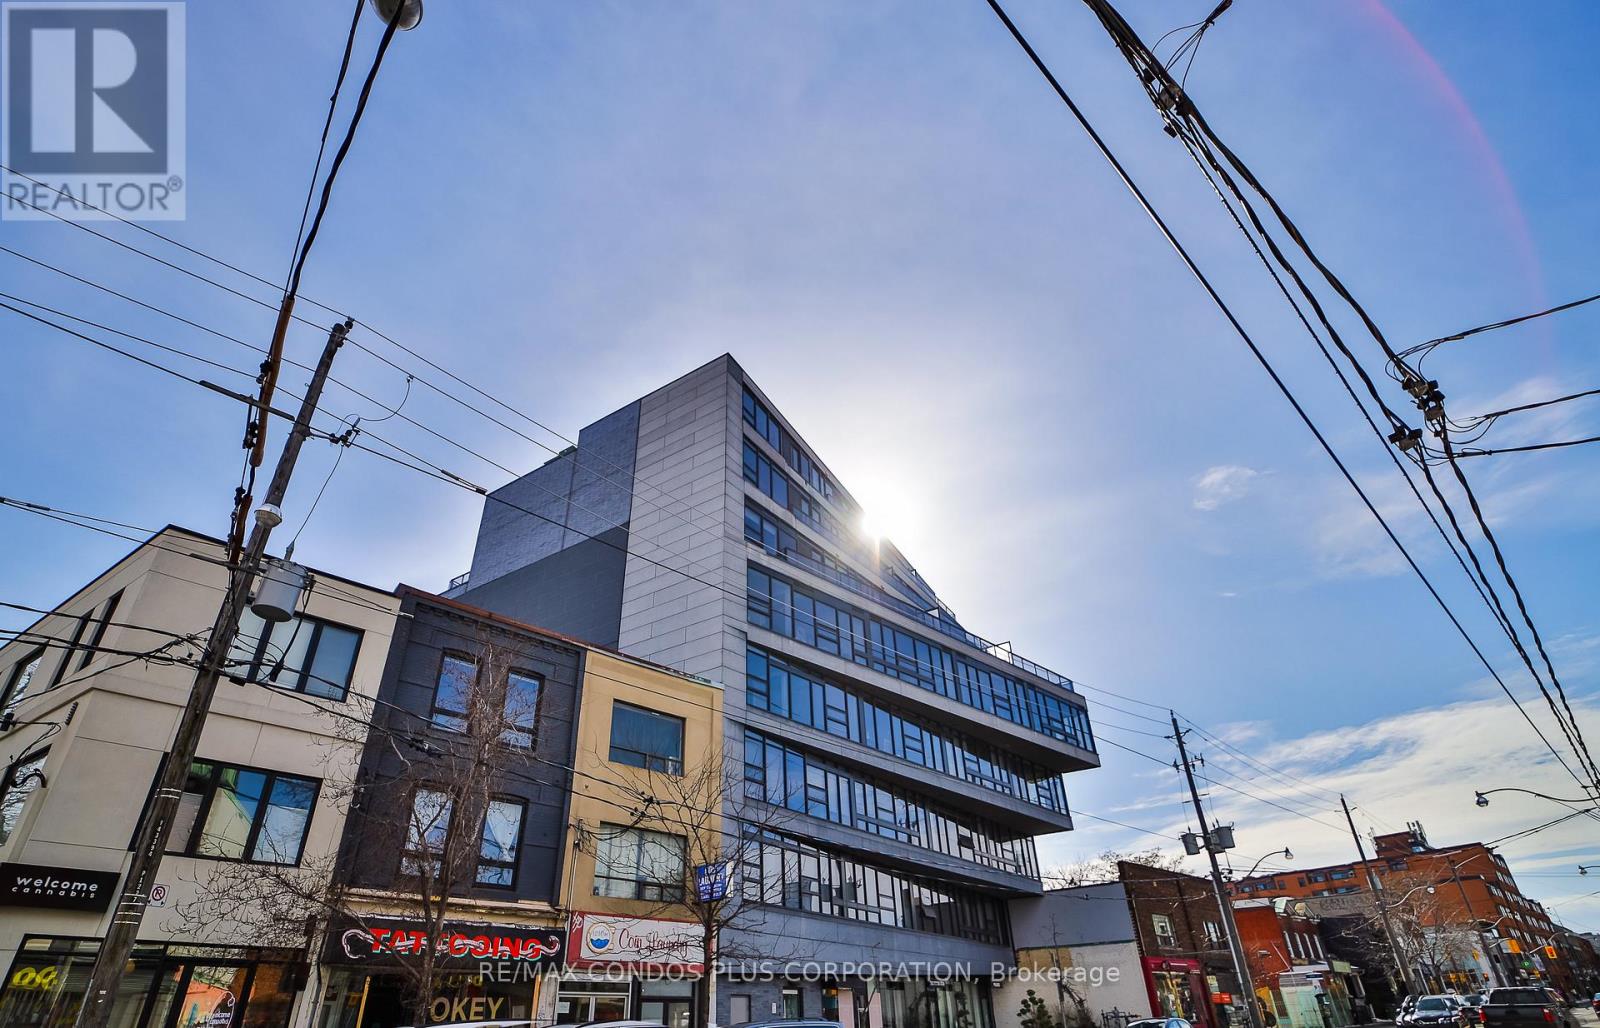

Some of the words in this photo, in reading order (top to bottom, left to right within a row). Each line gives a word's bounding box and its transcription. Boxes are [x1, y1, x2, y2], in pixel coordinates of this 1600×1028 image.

[16, 876, 98, 892] welcome
[11, 886, 96, 899] cannabis
[619, 928, 642, 949] Coin
